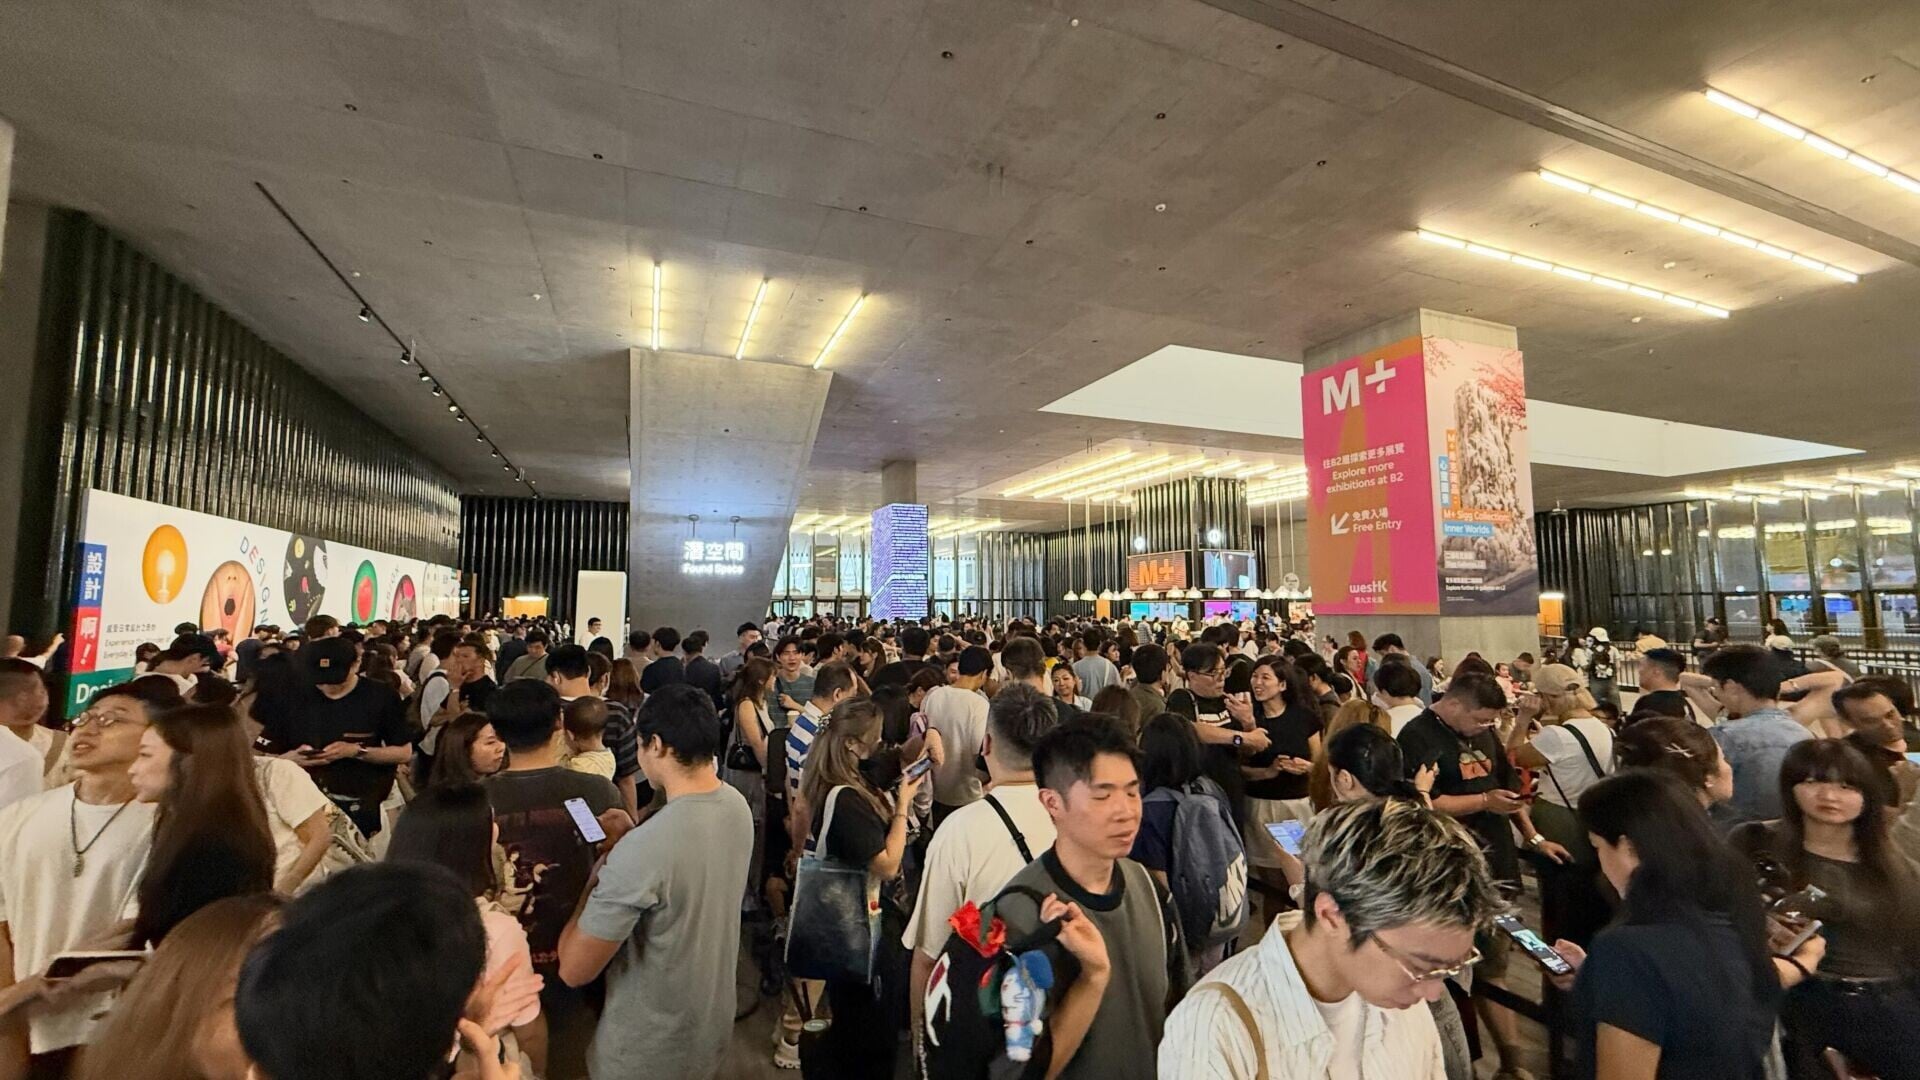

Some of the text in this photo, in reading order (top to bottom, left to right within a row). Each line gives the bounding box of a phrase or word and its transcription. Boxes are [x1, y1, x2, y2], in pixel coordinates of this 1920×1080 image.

[1322, 359, 1396, 416] M+
[1332, 462, 1395, 481] Explore more
[1326, 472, 1404, 494] exhibitions at B2
[1443, 509, 1457, 519] M+
[1457, 511, 1474, 521] Sigg
[1353, 520, 1402, 533] Free Entry
[1444, 523, 1491, 534] Inner Worlds
[714, 562, 745, 576] Space
[1138, 558, 1175, 587] M+
[240, 536, 271, 624] DESIGN
